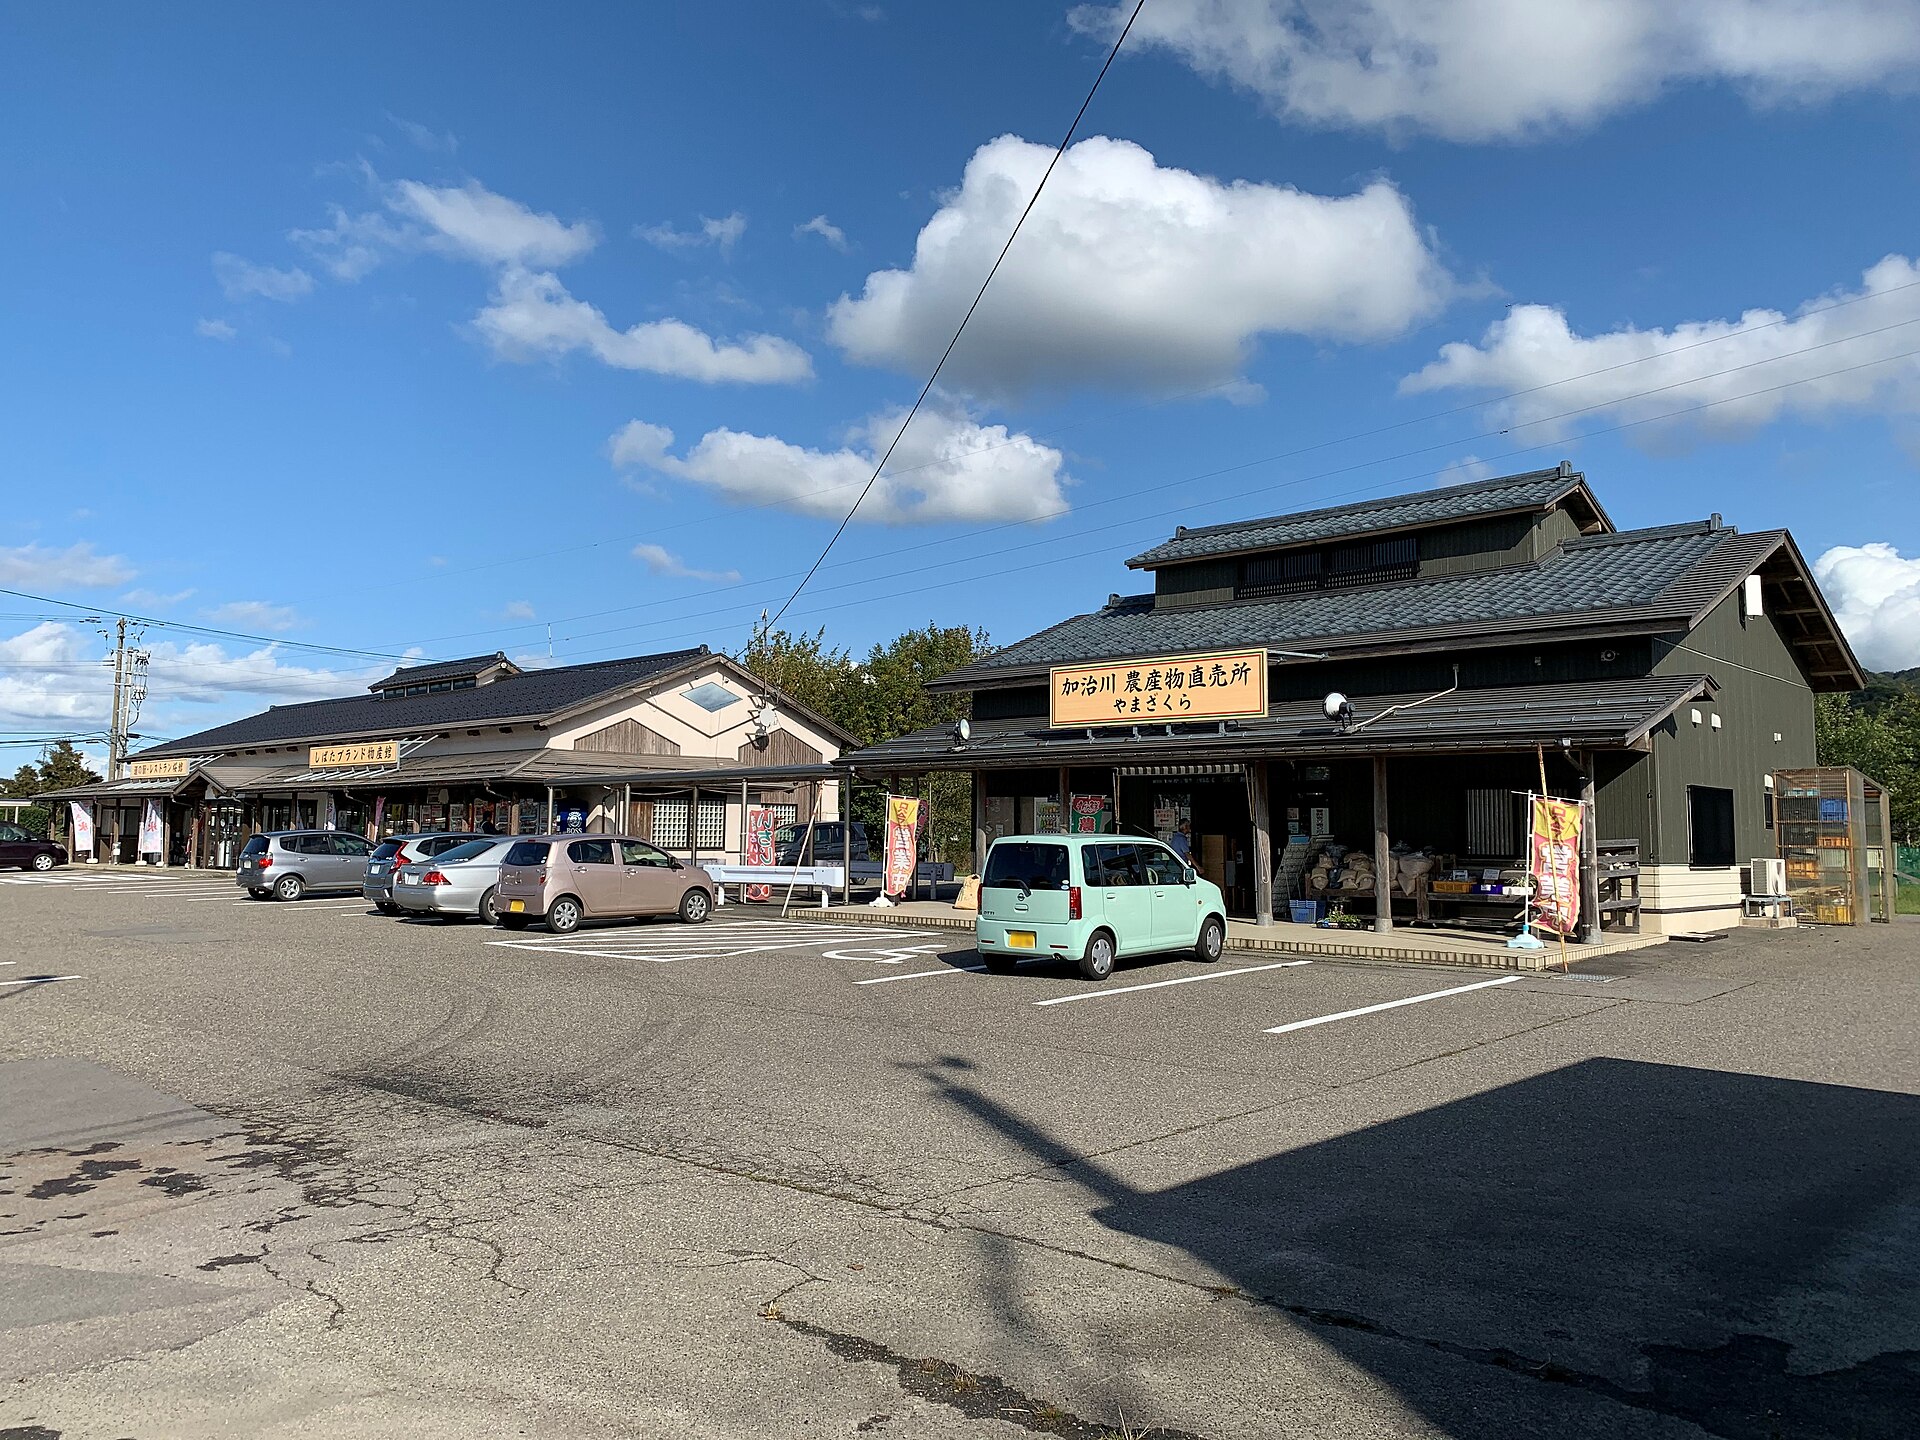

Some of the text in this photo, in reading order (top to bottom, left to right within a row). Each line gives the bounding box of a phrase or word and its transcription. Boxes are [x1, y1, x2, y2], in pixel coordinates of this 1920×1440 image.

[1061, 661, 1252, 696] 加治川 農産物直売所
[1113, 693, 1192, 713] やまざくら
[314, 745, 393, 763] しばたブランド物産館
